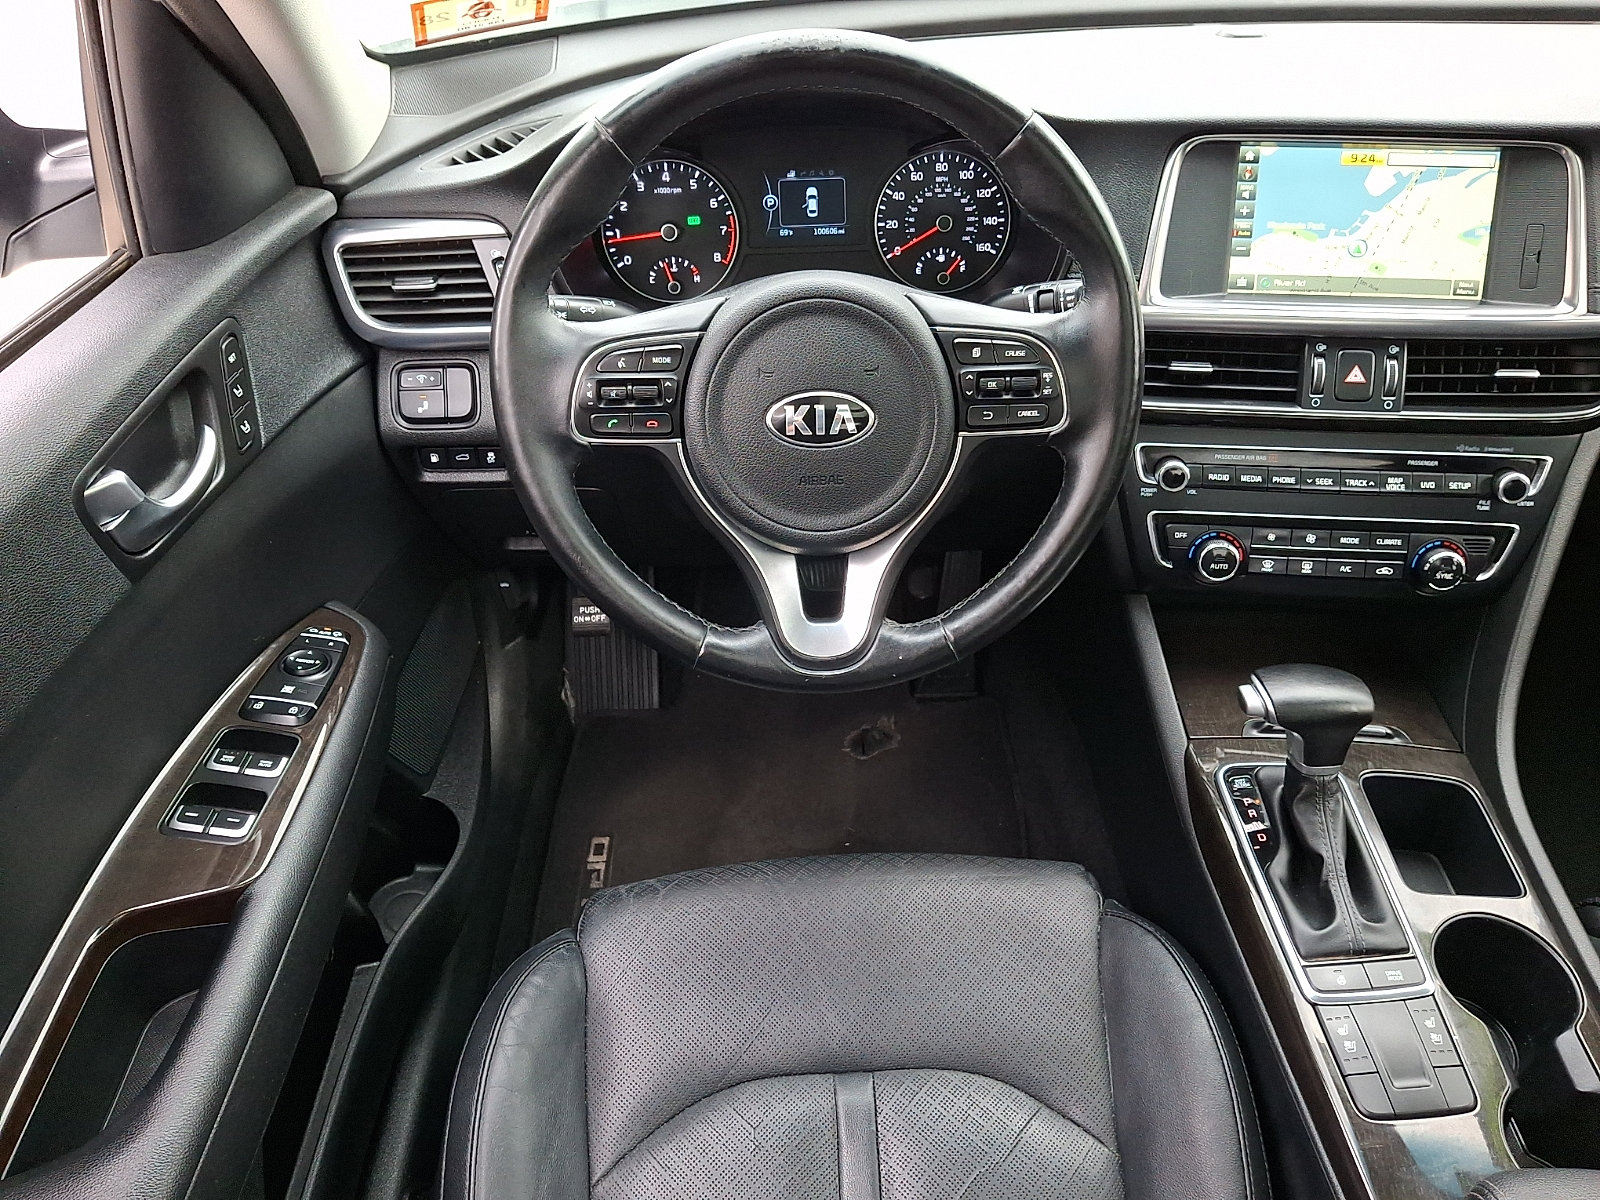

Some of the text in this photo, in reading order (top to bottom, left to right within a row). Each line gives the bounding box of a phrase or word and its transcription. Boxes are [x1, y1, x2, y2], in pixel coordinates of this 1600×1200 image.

[935, 163, 948, 171] 80
[661, 172, 670, 182] 4
[910, 172, 923, 181] 60
[959, 171, 975, 179] 100
[637, 181, 645, 192] 3
[689, 179, 697, 189] 5
[892, 191, 905, 200] 40
[976, 189, 991, 198] 120
[620, 202, 628, 212] 2
[709, 198, 718, 208] 6
[885, 220, 899, 229] 20
[982, 216, 997, 225] 140
[720, 226, 727, 235] 7
[976, 243, 991, 251] 160
[623, 255, 632, 265] 0
[713, 253, 721, 262] 8
[915, 267, 922, 275] E
[1273, 279, 1306, 287] River Rd
[652, 356, 671, 364] MODE
[783, 404, 857, 435] KIA
[799, 475, 844, 485] AIRBAG
[1208, 473, 1230, 482] RADIO
[1240, 474, 1262, 483] MEDIA
[1272, 476, 1296, 484] PHONE
[1315, 477, 1334, 486] SEEK
[1345, 479, 1368, 487] TRACK
[1386, 483, 1406, 491] VOICE
[1448, 482, 1472, 490] SETUP
[1376, 538, 1402, 546] CLIMATE
[1434, 571, 1454, 579] SYNC
[573, 614, 607, 623] ON OFF
[1242, 797, 1252, 807] P
[1247, 808, 1257, 818] R
[1257, 833, 1267, 842] D
